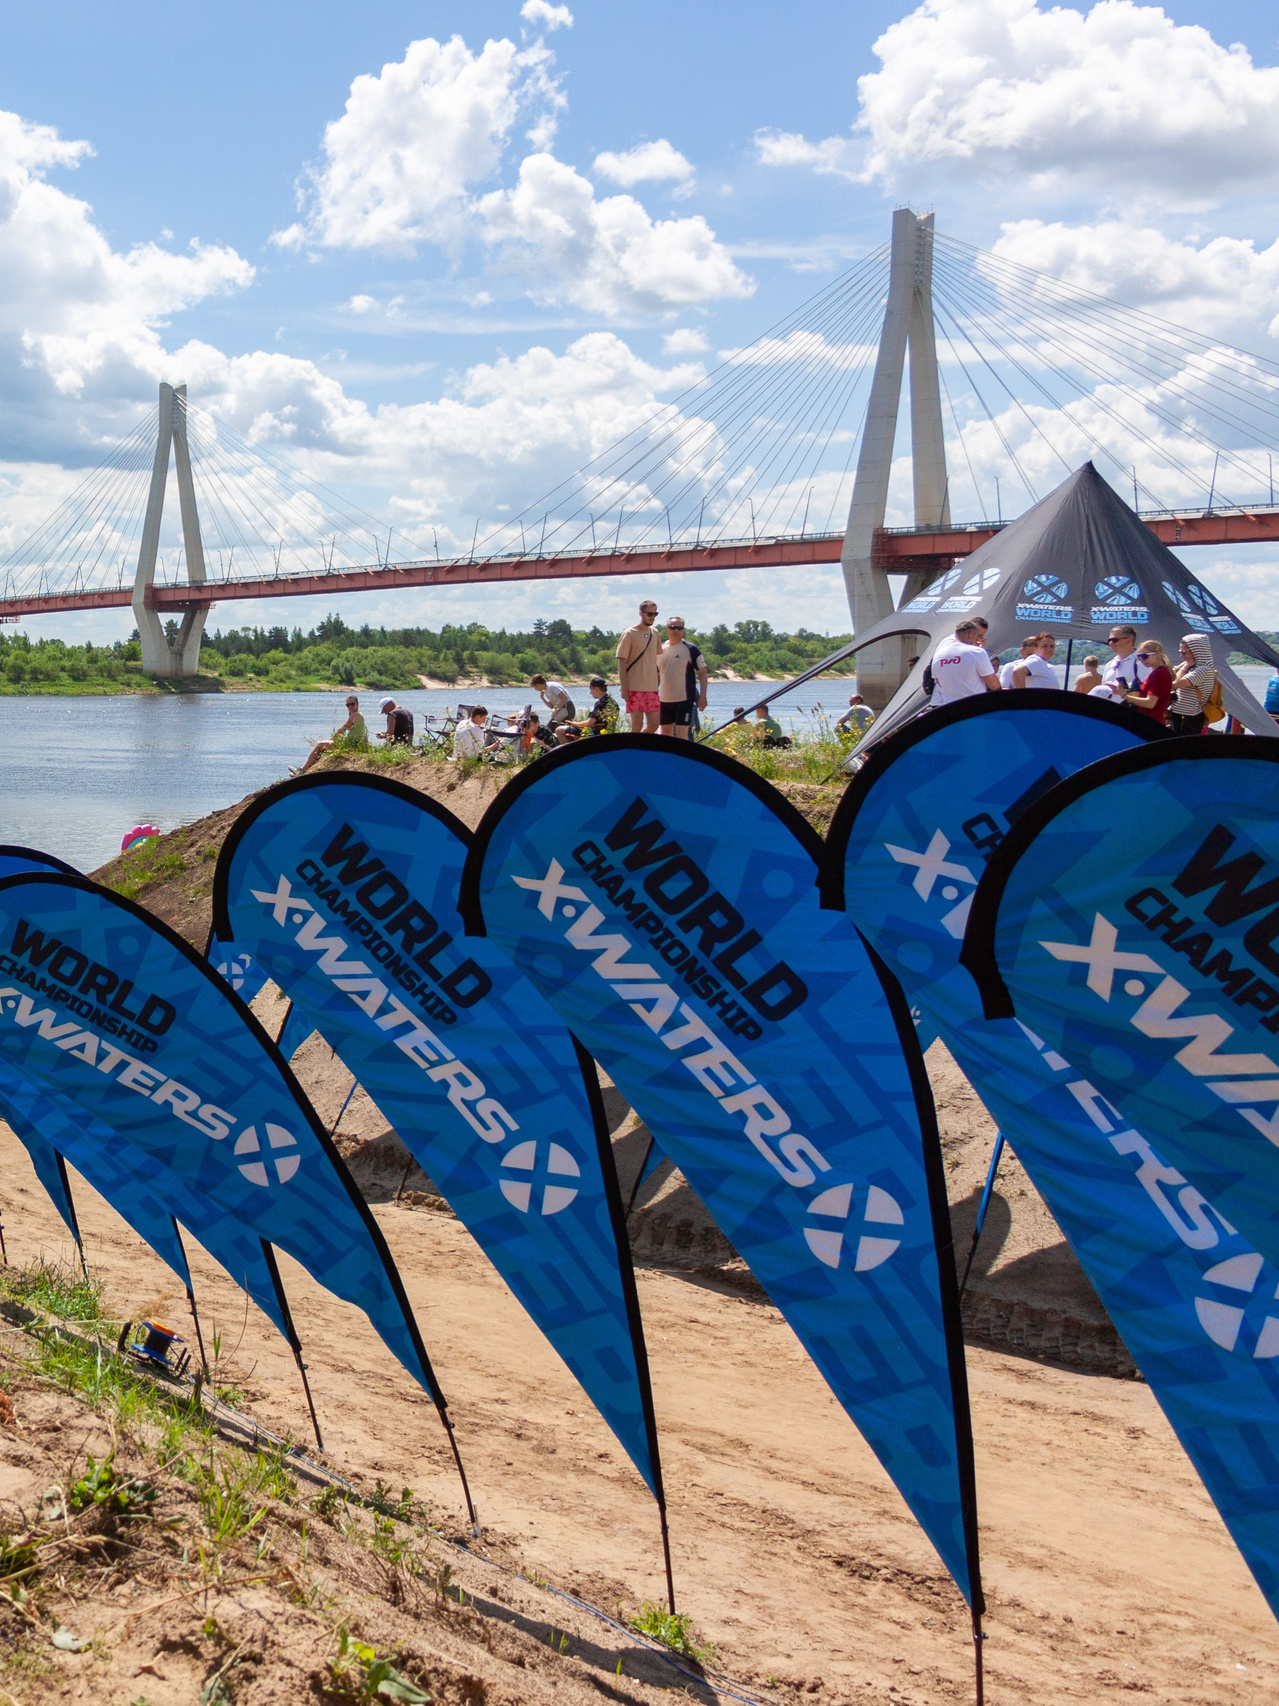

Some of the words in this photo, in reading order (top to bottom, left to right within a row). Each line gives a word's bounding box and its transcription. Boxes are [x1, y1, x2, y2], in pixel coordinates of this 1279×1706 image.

[1016, 608, 1071, 619] WORLD
[1091, 611, 1148, 620] WORLD
[10, 918, 177, 1036] WORLD
[295, 858, 458, 1025] CHAMPIONSHIP
[320, 821, 492, 1008] WORLD
[571, 840, 764, 1042] CHAMPIONSHIP
[603, 795, 808, 1022] WORLD
